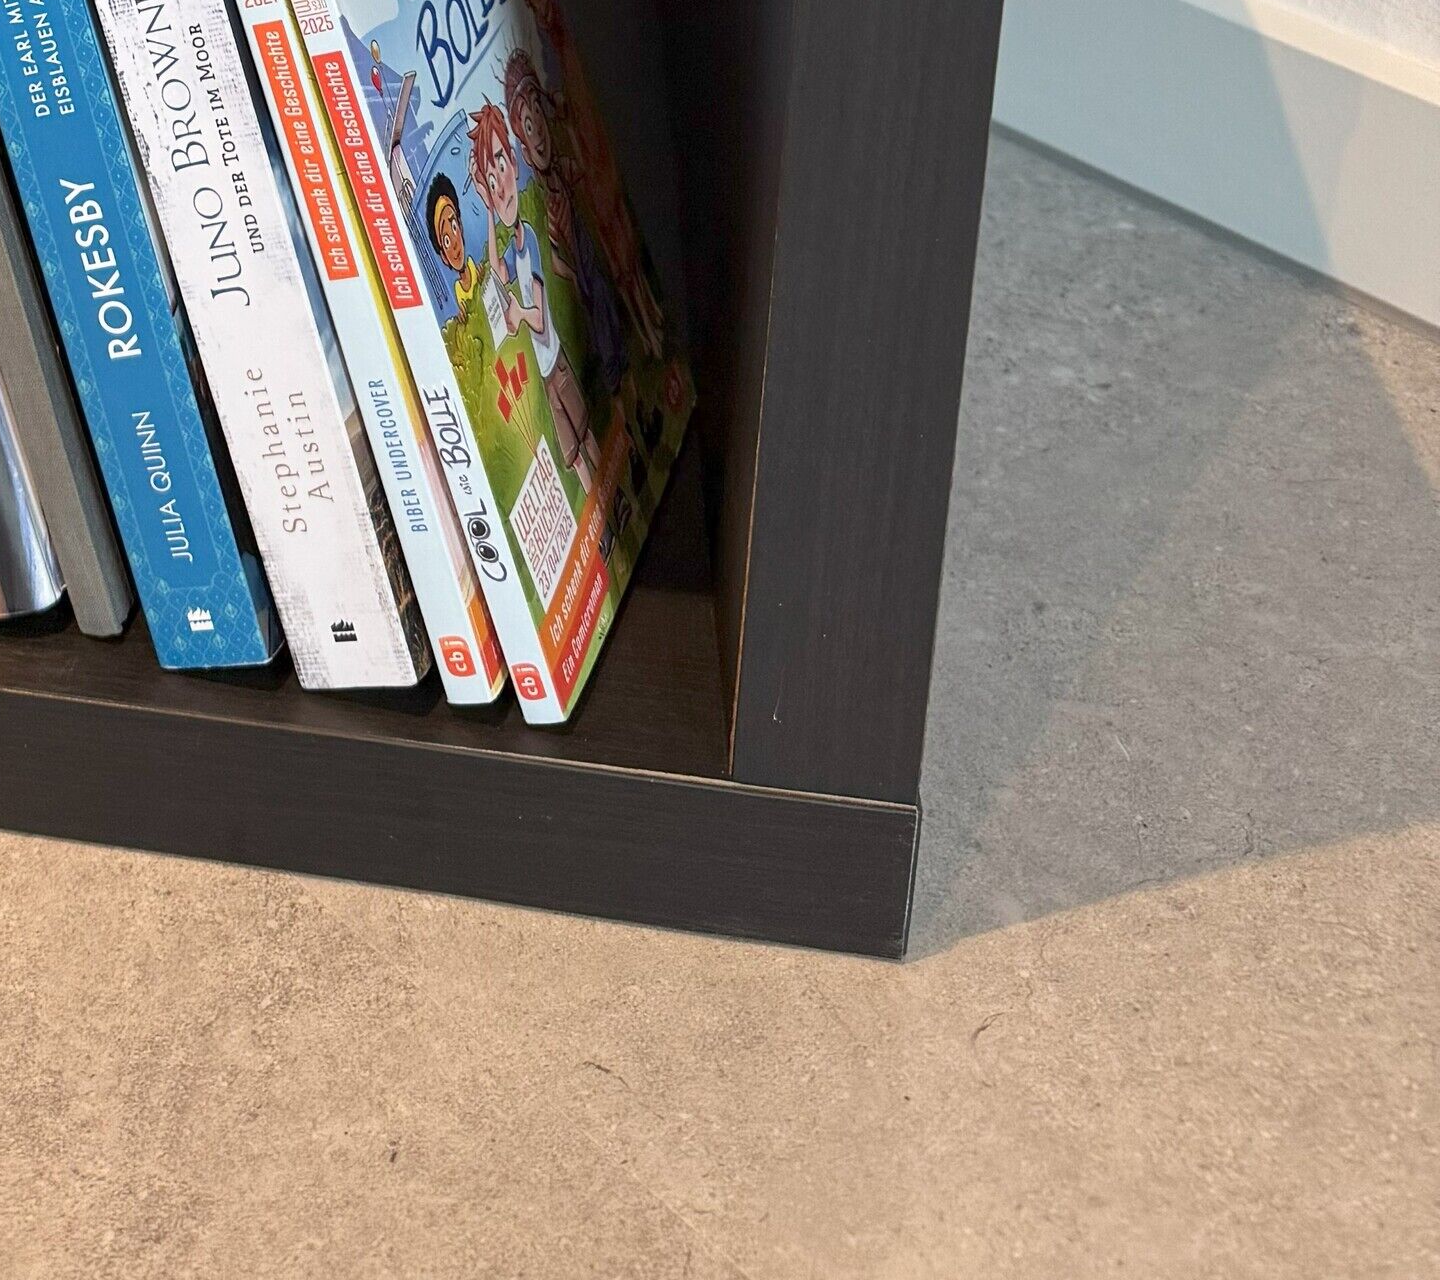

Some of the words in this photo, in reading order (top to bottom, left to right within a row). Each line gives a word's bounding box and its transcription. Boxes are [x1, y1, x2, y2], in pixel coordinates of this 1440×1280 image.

[14, 29, 39, 77] EARL
[189, 22, 216, 81] MOOR
[300, 14, 334, 36] 2025
[33, 11, 75, 115] EISBLAUEN
[265, 30, 302, 117] Geschichte
[28, 80, 51, 118] DER
[206, 88, 225, 112] IM
[324, 60, 364, 147] Geschichte
[216, 116, 240, 167] TOTE
[293, 120, 315, 155] eine
[231, 170, 252, 208] DER
[303, 157, 323, 184] dir
[354, 150, 376, 185] eine
[311, 187, 342, 242] schenk
[363, 188, 386, 214] dir
[193, 186, 251, 307] JUNO
[244, 213, 264, 254] UND
[326, 247, 349, 273] Ich
[373, 217, 405, 270] schenk
[60, 178, 142, 360] ROKESBY
[392, 275, 414, 302] Ich
[131, 410, 172, 493] QUINN
[245, 367, 308, 533] Stephanie
[286, 390, 334, 503] Austin
[368, 378, 412, 482] UNDERCOVER
[423, 384, 472, 469] BOLLE
[402, 488, 428, 532] BIBER
[514, 447, 553, 544] WELTTAG
[532, 476, 564, 556] BUCHES
[160, 498, 194, 563] JULIA
[464, 498, 507, 582] COOL
[538, 507, 573, 599] 23/04/2025
[549, 608, 563, 648] Ich
[561, 559, 584, 626] schenk
[579, 534, 591, 569] dir
[444, 640, 468, 672] cbj
[561, 654, 574, 684] Ein
[571, 572, 603, 661] Comicroman
[517, 667, 539, 696] cbj
